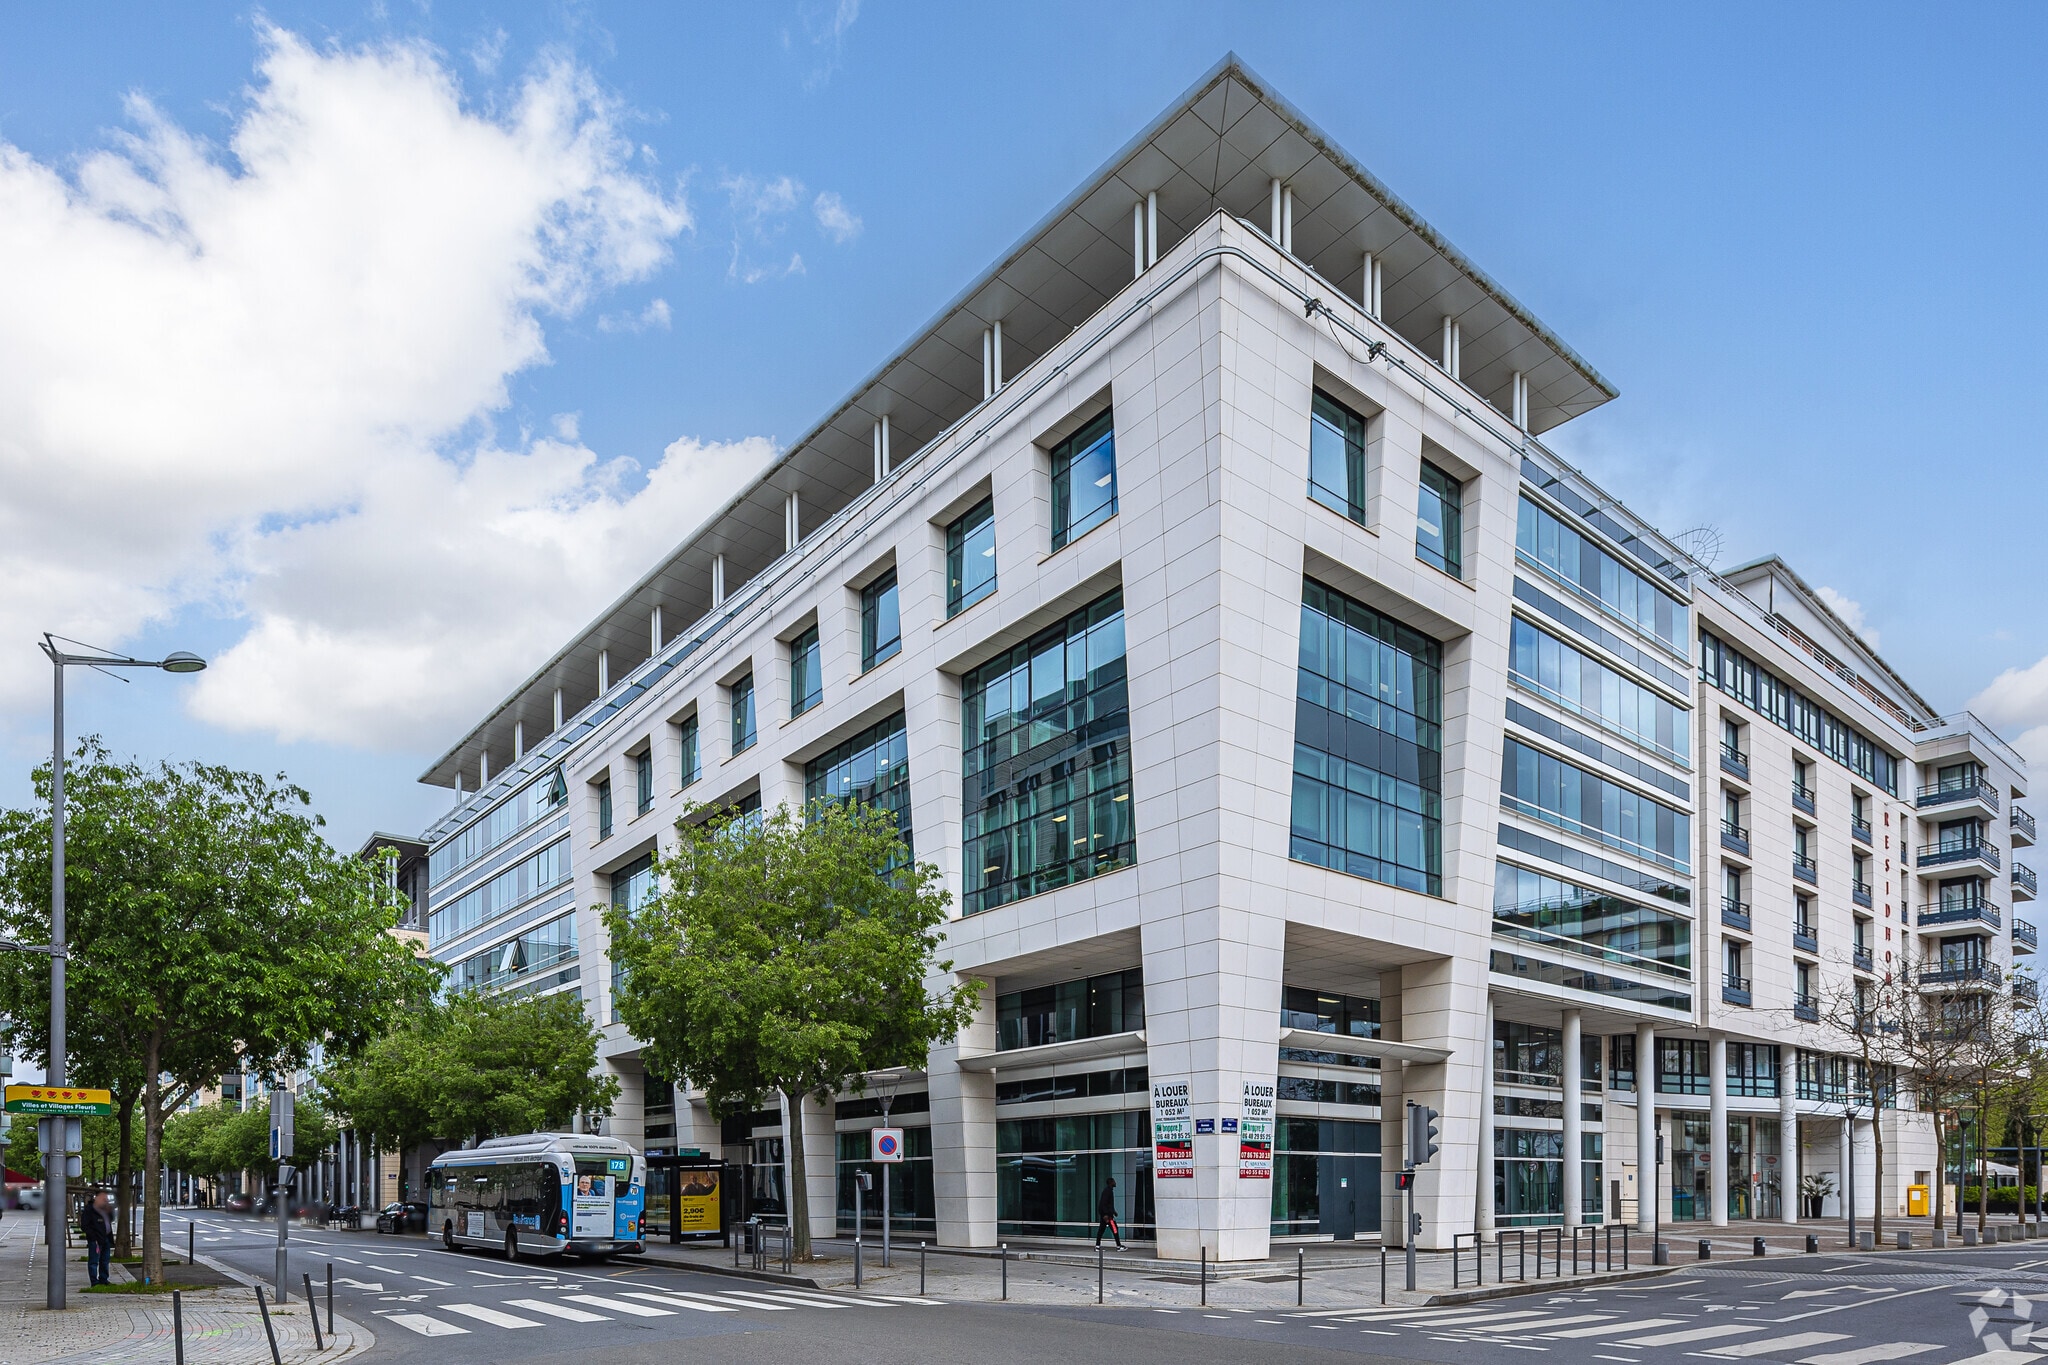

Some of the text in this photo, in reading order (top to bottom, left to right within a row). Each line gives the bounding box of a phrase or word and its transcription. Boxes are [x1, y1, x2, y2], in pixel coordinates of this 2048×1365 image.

[1884, 812, 1892, 1010] RESIDHOME
[1154, 1084, 1188, 1097] À LOUER
[1244, 1082, 1273, 1097] À LOUER
[1156, 1098, 1188, 1108] BUREAUX
[1245, 1098, 1272, 1108] BUREAUX
[612, 1162, 624, 1170] 178
